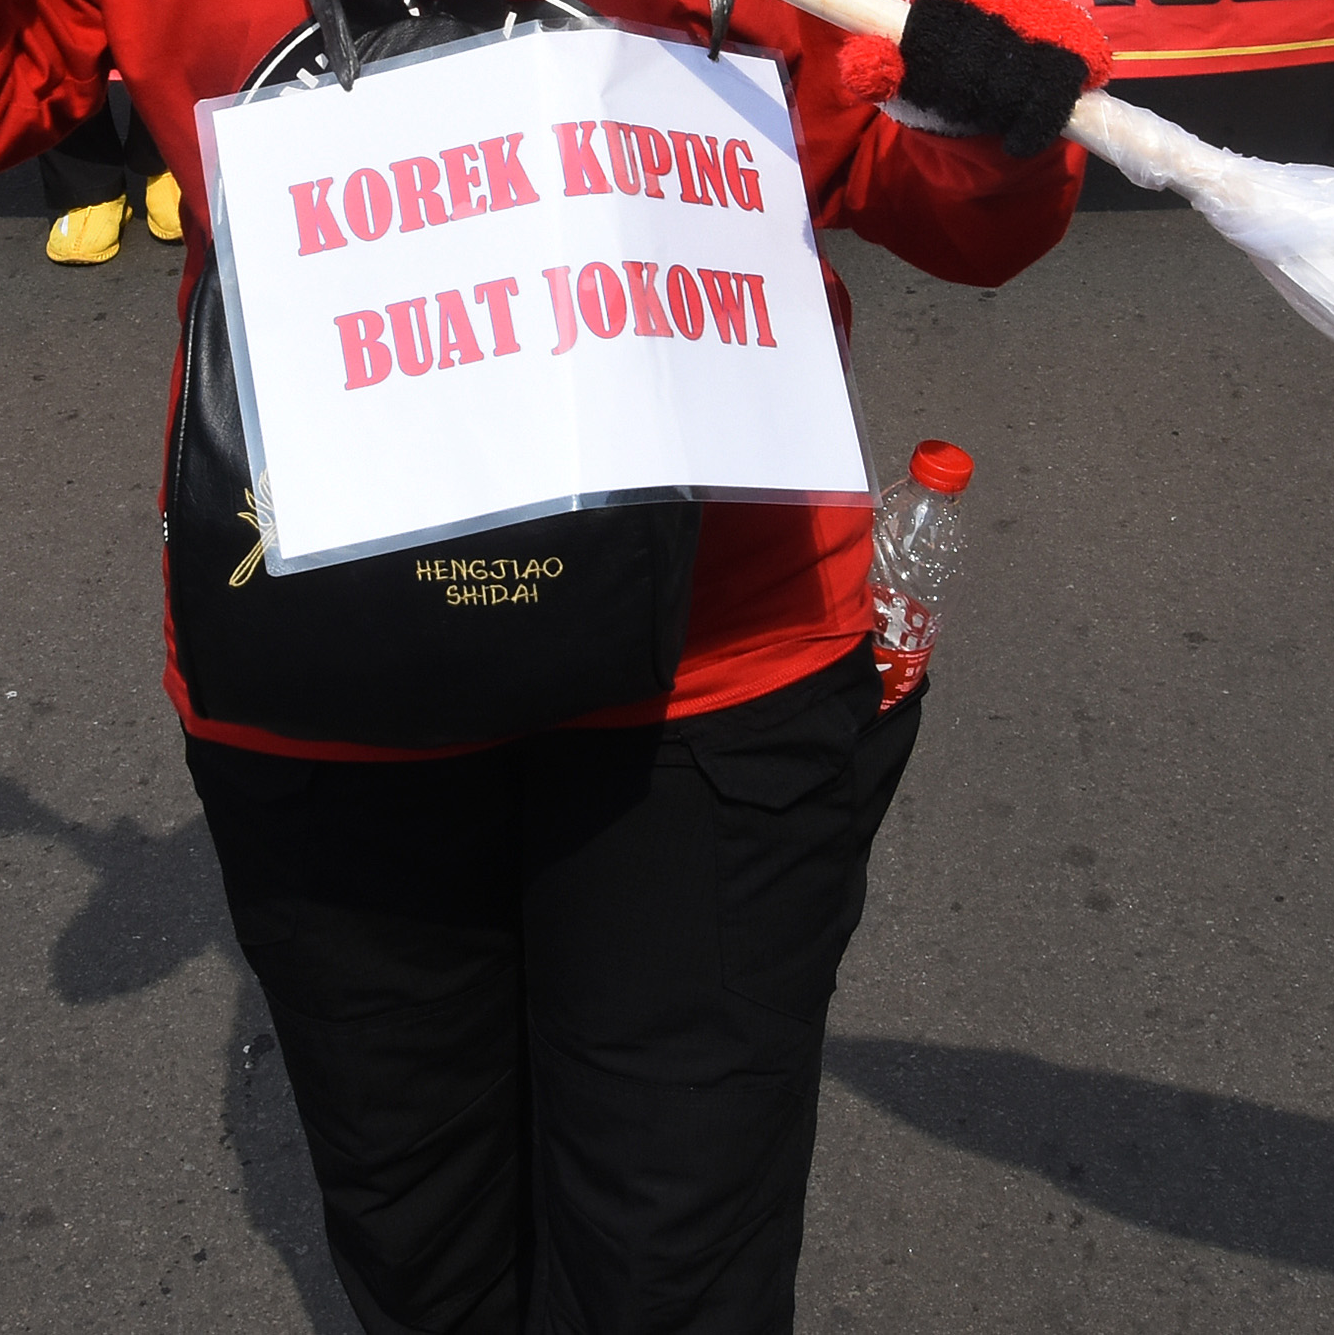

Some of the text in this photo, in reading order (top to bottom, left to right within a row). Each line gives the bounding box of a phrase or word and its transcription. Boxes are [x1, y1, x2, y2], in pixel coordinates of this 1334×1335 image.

[287, 119, 766, 257] KOREK KUPING
[333, 260, 778, 391] BUAT JOKOWI
[416, 556, 564, 582] HENGJIAO
[445, 583, 539, 606] SHIDAI
